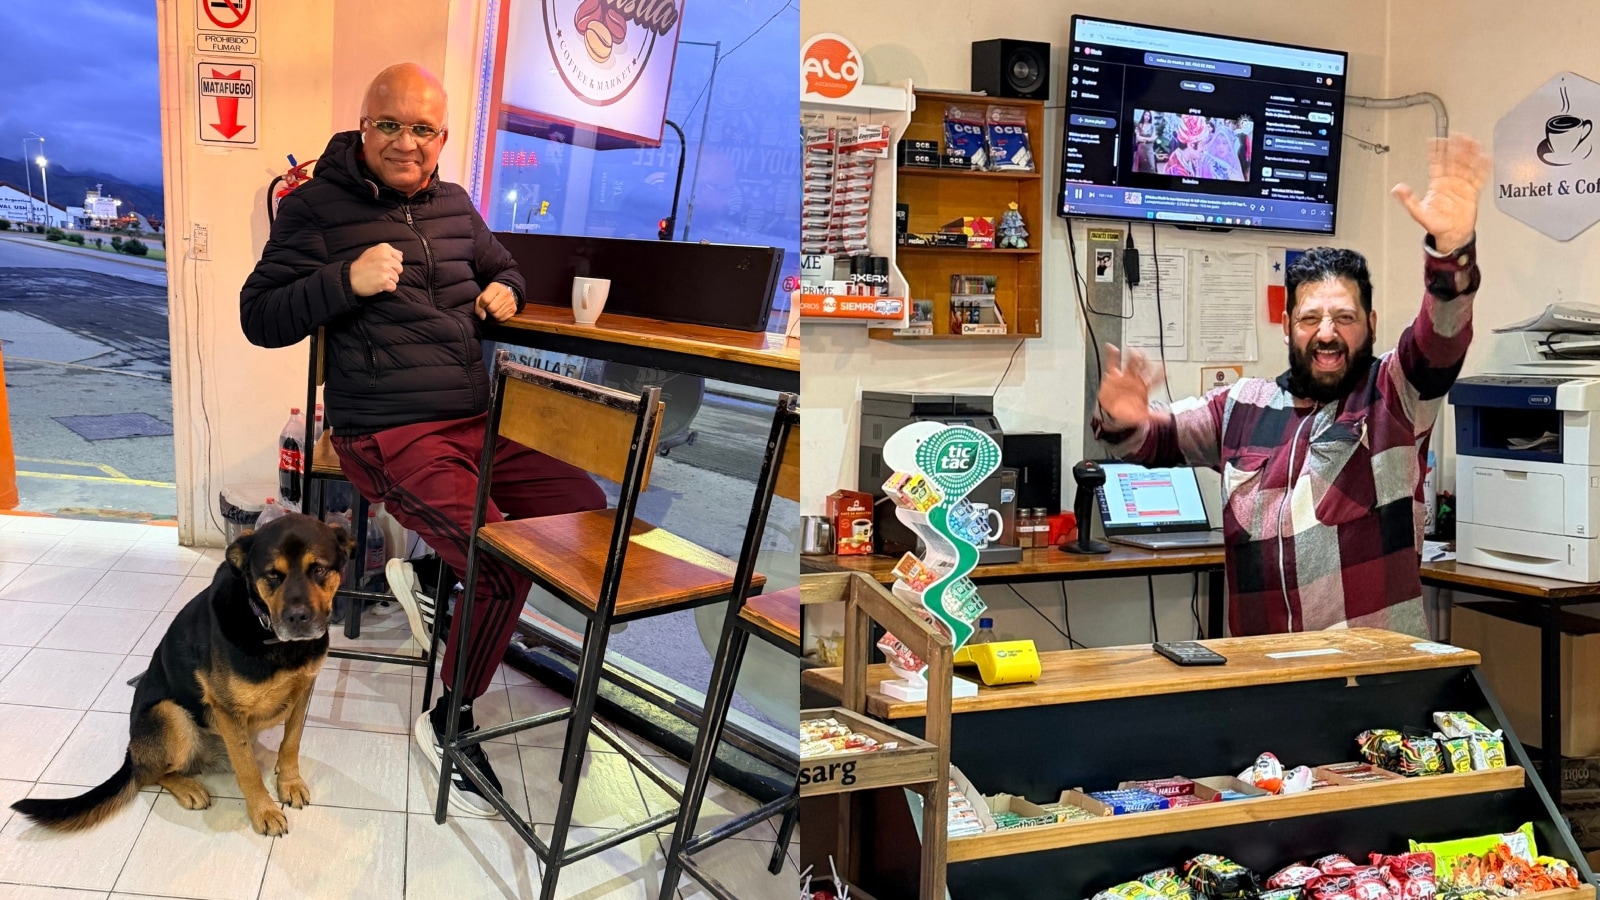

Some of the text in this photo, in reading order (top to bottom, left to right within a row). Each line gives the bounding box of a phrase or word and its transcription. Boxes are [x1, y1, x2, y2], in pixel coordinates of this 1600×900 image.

[205, 35, 249, 45] PROHIBIDO
[212, 43, 241, 52] FUMAR
[559, 40, 588, 86] COFFEE
[597, 64, 632, 91] MARKET
[802, 51, 859, 82] ALÓ
[203, 81, 251, 95] MATAFUEGO
[954, 123, 982, 135] OCB
[994, 125, 1022, 135] OCB
[915, 155, 930, 163] OCB
[949, 157, 964, 165] OCB
[1499, 178, 1600, 199] Market & Cof
[873, 273, 888, 282] AX
[840, 301, 876, 311] SIEMPR
[948, 443, 972, 458] tic
[941, 455, 970, 470] tac
[800, 760, 857, 785] sarg
[1159, 786, 1180, 795] HALLS
